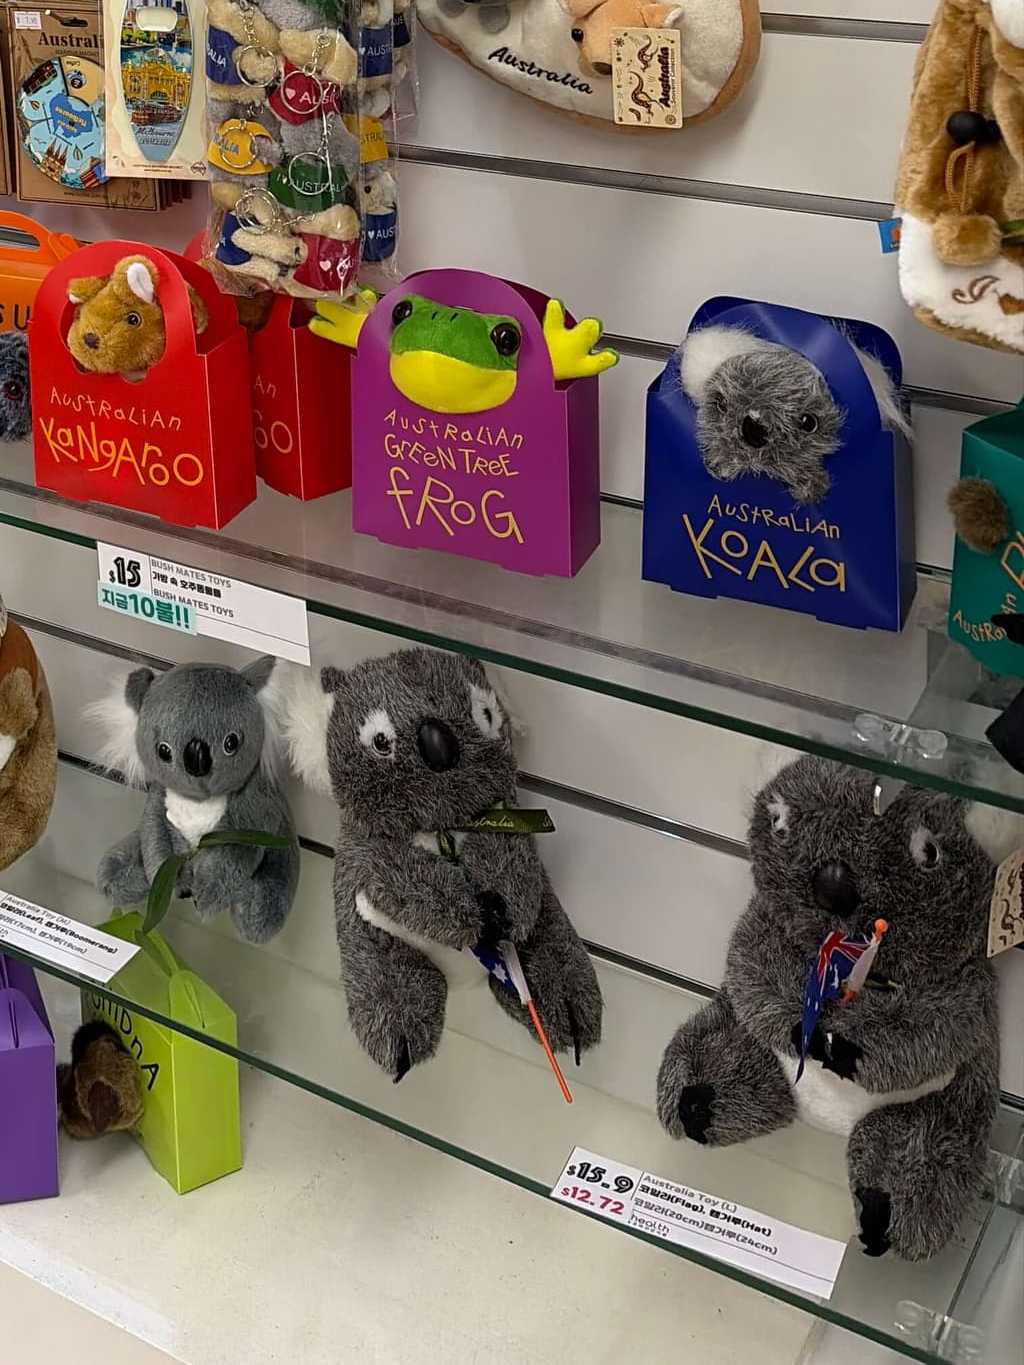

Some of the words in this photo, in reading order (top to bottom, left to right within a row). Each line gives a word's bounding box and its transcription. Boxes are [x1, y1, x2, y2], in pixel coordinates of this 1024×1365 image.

[488, 46, 594, 95] Australia
[657, 47, 671, 108] Australia
[288, 179, 342, 193] AUSTRAL
[109, 556, 141, 588] $15
[151, 559, 174, 573] BUSH
[176, 566, 206, 581] MATES
[208, 574, 232, 588] TOYS
[102, 588, 190, 628] 지금10불!!
[154, 588, 176, 602] BUSH
[178, 595, 209, 611] MATES
[211, 604, 234, 618] TOYS
[566, 1162, 634, 1194] $15.9
[643, 1175, 695, 1198] Australia
[697, 1193, 720, 1208] Toy
[721, 1200, 737, 1213] (L)
[561, 1185, 625, 1215] $12.72
[631, 1212, 670, 1233] health
